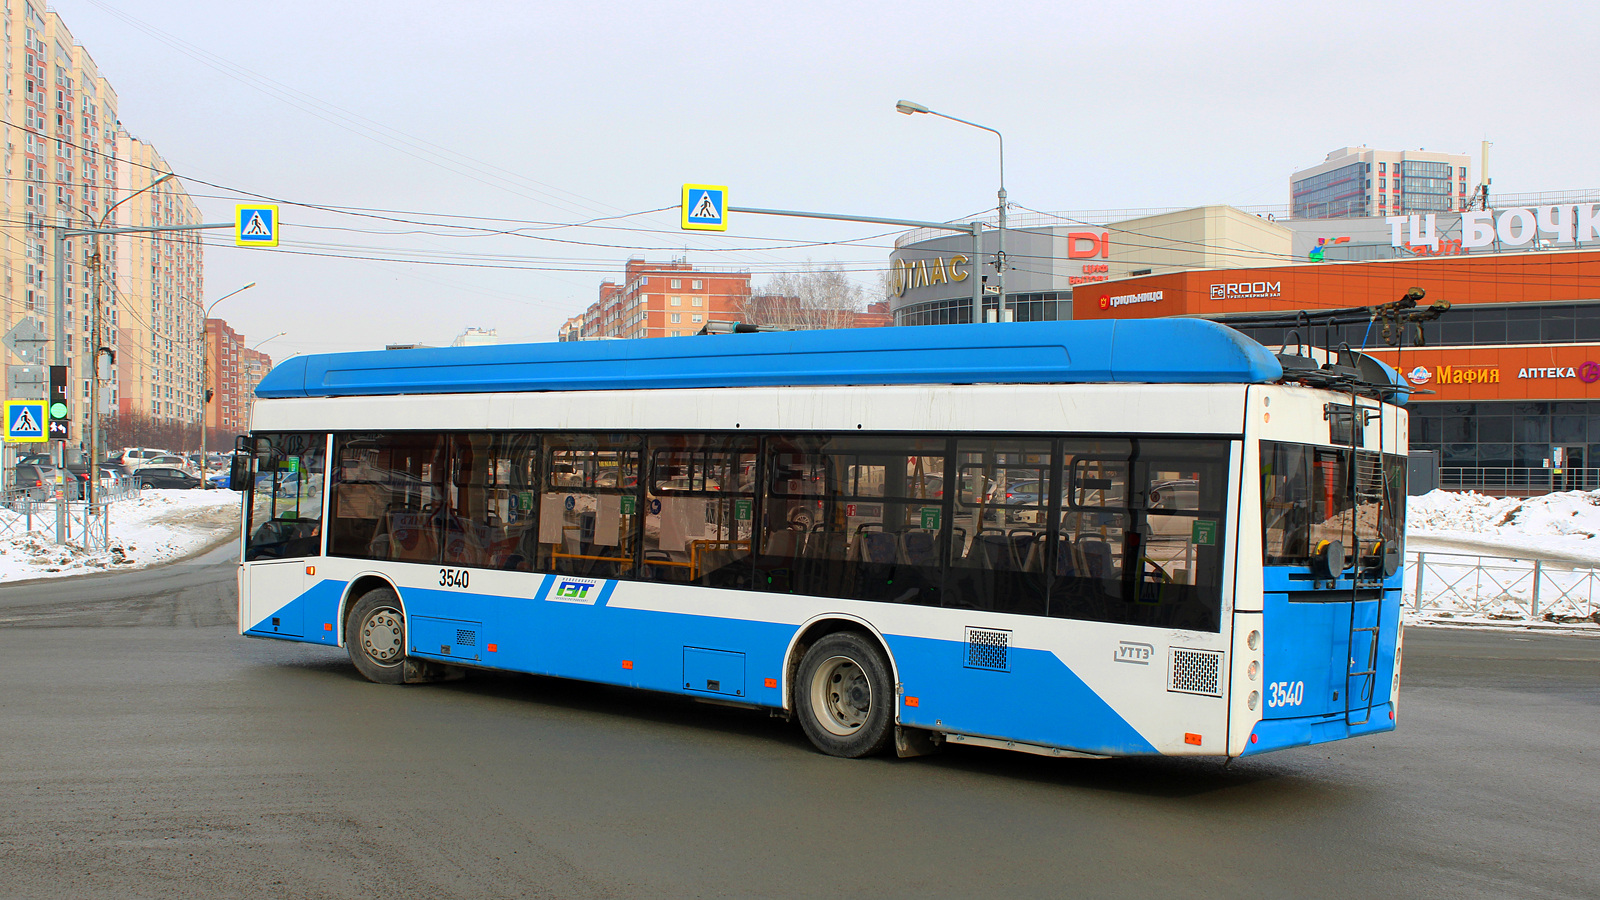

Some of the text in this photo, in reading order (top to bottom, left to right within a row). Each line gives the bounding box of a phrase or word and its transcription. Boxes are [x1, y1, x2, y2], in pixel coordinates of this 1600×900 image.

[1385, 213, 1438, 251] ТЦ
[1227, 281, 1281, 295] ROOM
[1436, 365, 1500, 384] Мафия
[1518, 367, 1576, 378] АПТЕКА
[58, 386, 68, 399] 4
[439, 568, 470, 589] 3540
[1268, 681, 1304, 708] 3540
